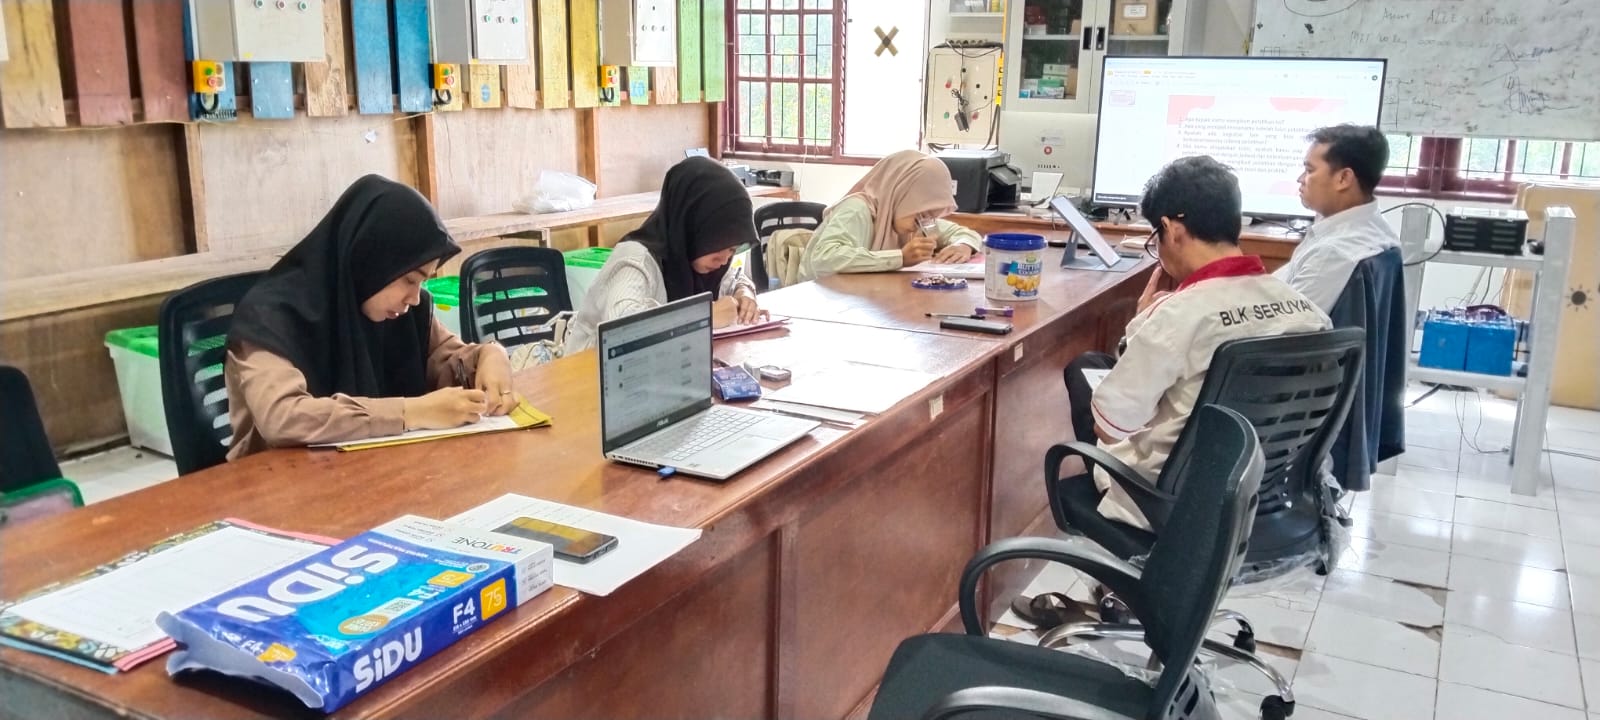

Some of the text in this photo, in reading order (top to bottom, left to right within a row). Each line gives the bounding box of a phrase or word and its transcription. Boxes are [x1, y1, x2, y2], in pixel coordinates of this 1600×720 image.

[1219, 306, 1249, 327] BLK
[450, 536, 523, 556] TRUTONE
[453, 587, 503, 625] F4 75
